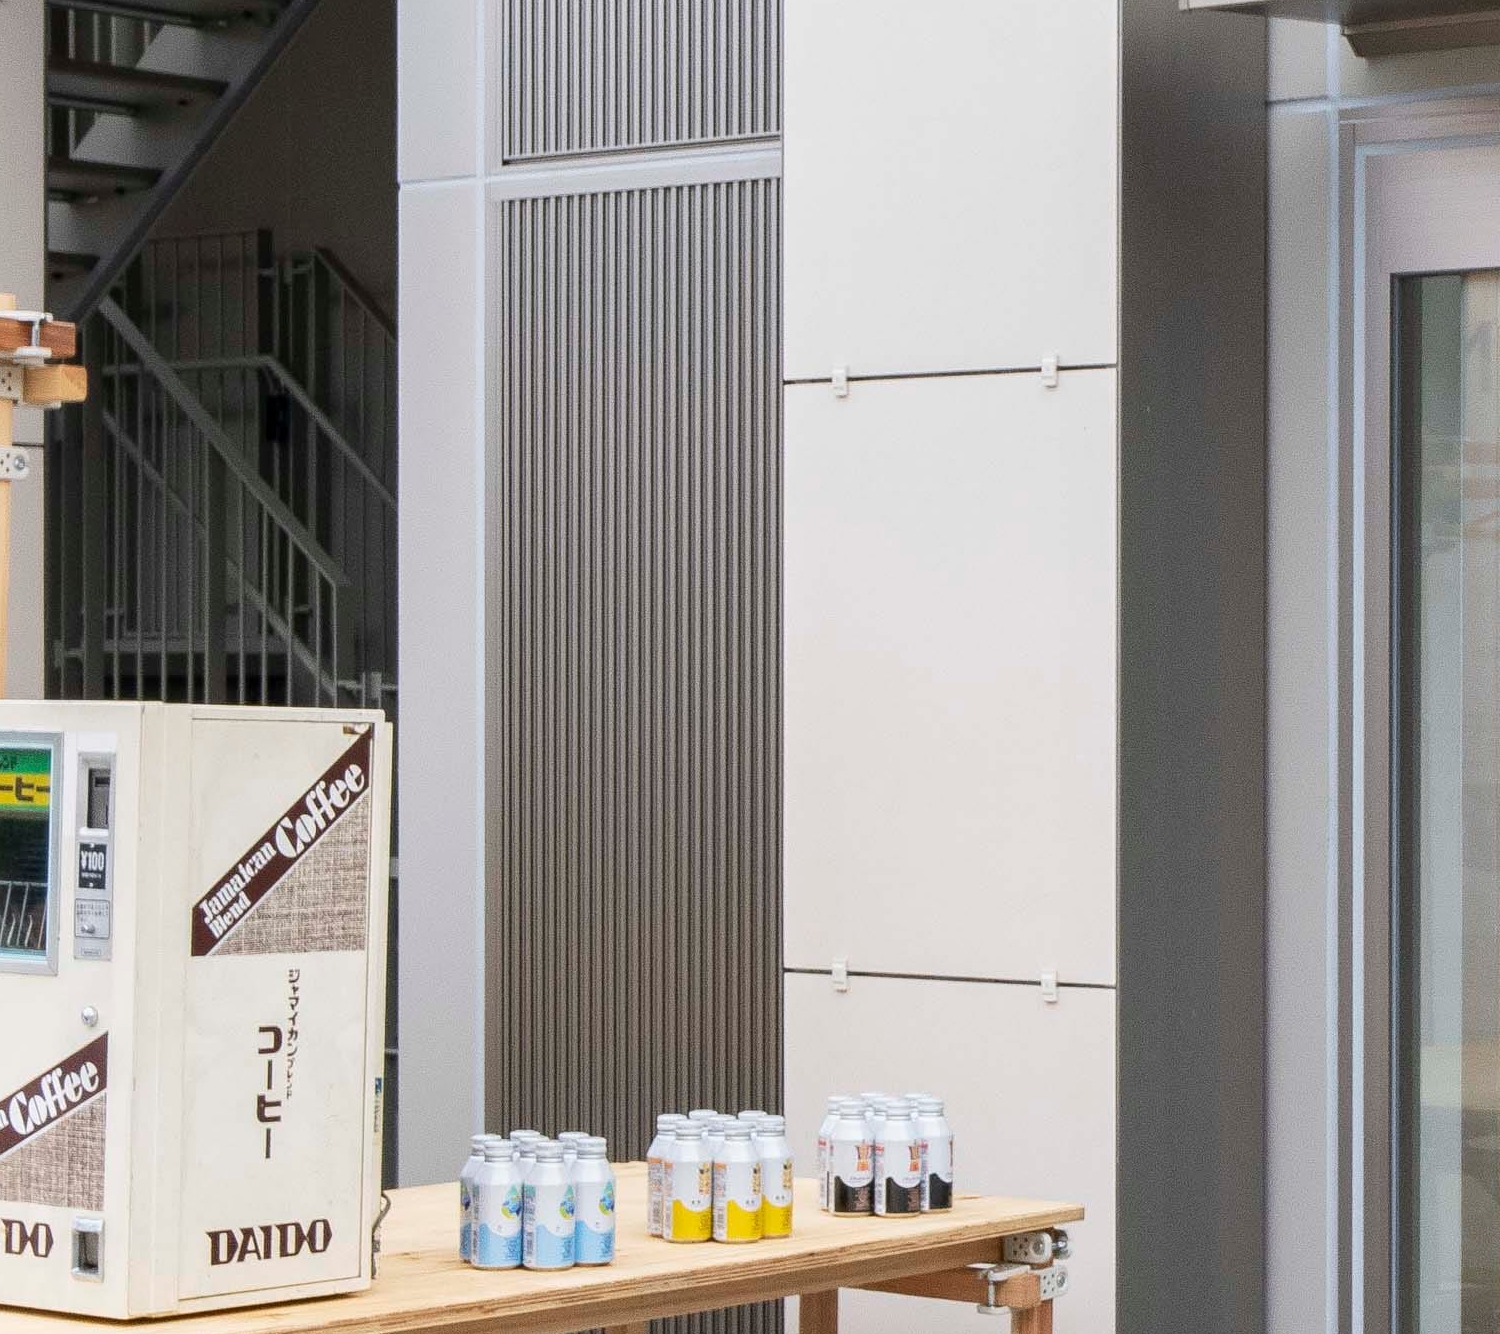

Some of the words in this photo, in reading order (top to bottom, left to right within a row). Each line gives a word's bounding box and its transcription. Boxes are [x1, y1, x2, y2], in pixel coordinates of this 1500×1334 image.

[80, 850, 105, 871] ¥100
[199, 841, 277, 925] Jamaican
[275, 763, 366, 858] Coffee
[204, 890, 252, 939] Blend
[8, 1061, 100, 1135] Coffee
[256, 1025, 283, 1159] コーヒー
[205, 1218, 333, 1266] DAIDO
